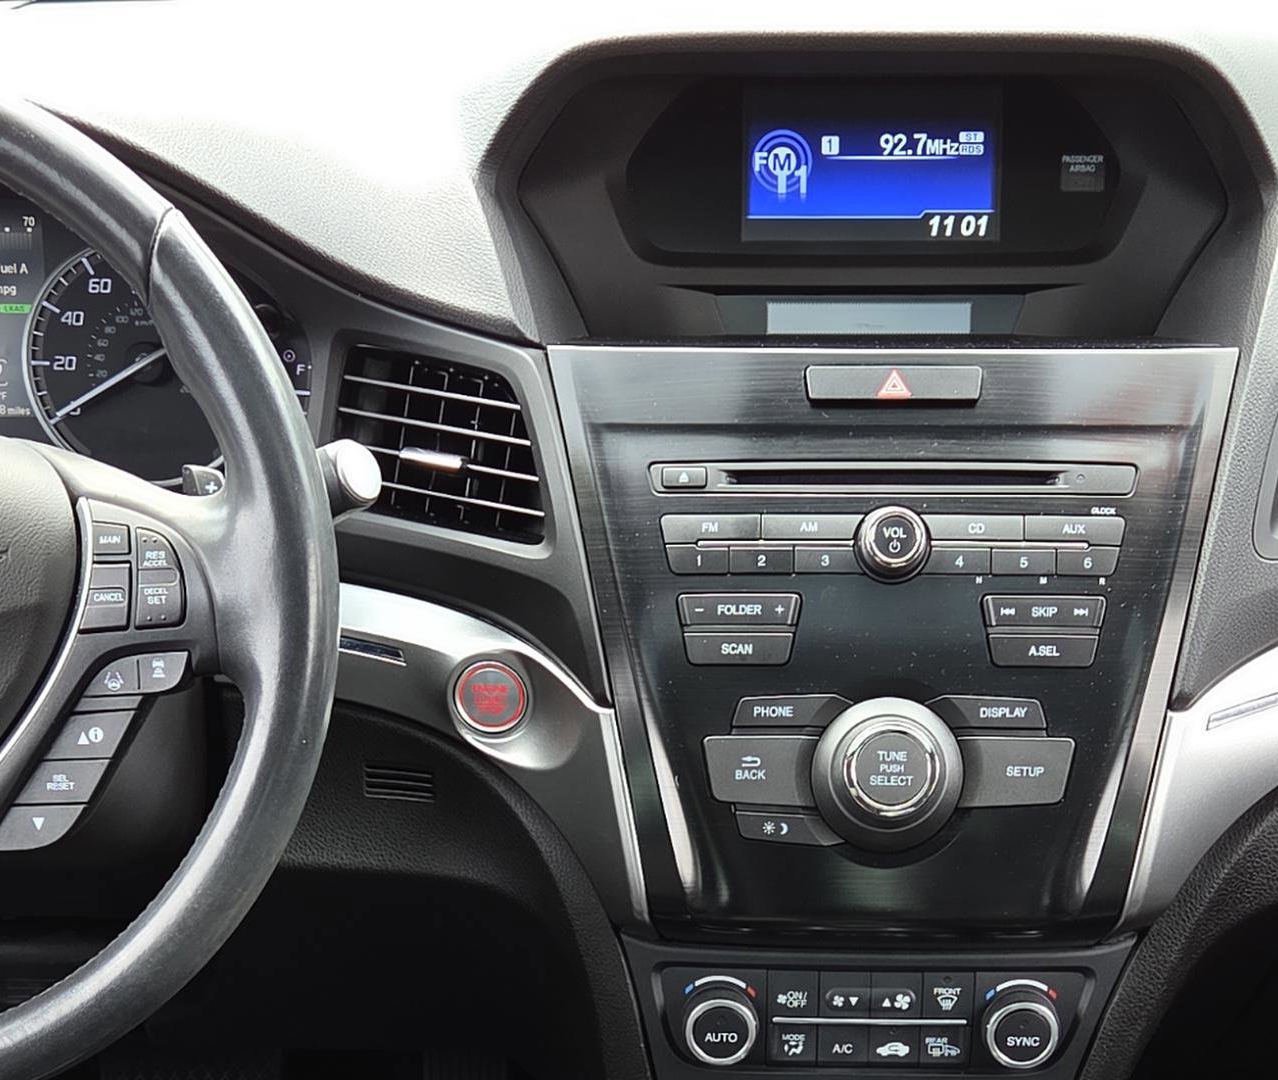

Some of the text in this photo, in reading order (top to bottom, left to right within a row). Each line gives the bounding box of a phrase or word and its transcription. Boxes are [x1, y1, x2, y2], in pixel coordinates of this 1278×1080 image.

[964, 133, 979, 142] ST
[960, 145, 982, 155] RDS
[22, 216, 36, 226] 70
[19, 263, 29, 275] A
[87, 278, 112, 294] 60
[60, 310, 85, 326] 40
[52, 355, 77, 371] 20
[296, 364, 307, 376] F
[7, 406, 31, 416] miles
[701, 521, 719, 533] FM
[799, 521, 818, 533] AM
[882, 526, 907, 539] VOL
[968, 523, 986, 534] CD
[1062, 523, 1086, 535] AUX
[98, 535, 122, 545] MAIN
[145, 551, 166, 560] RES
[695, 555, 702, 567] 1
[756, 555, 767, 567] 2
[820, 555, 830, 567] 3
[954, 556, 964, 568] 4
[1019, 556, 1029, 568] 5
[1083, 557, 1093, 569] 6
[975, 576, 983, 585] H
[1039, 577, 1048, 585] M
[1098, 577, 1106, 586] R
[93, 592, 125, 603] CANCEL
[147, 595, 168, 605] SET
[717, 604, 762, 616] FOLDER
[1030, 606, 1058, 619] SKIP
[720, 643, 753, 655] SCAN
[1028, 645, 1061, 657] A.SEL
[752, 705, 794, 718] PHONE
[979, 706, 1028, 720] DISPLAY
[876, 750, 908, 763] TUNE
[734, 768, 767, 781] BACK
[879, 763, 905, 774] PUSH
[1005, 765, 1045, 778] SETUP
[46, 781, 75, 792] RESET
[868, 774, 914, 787] SELECT
[933, 987, 962, 996] FRONT
[786, 999, 807, 1009] OFF
[704, 1031, 738, 1044] AUTO
[782, 1033, 806, 1041] MODE
[925, 1036, 948, 1045] REAR
[1006, 1034, 1041, 1048] SYNC
[832, 1043, 854, 1055] A/C
